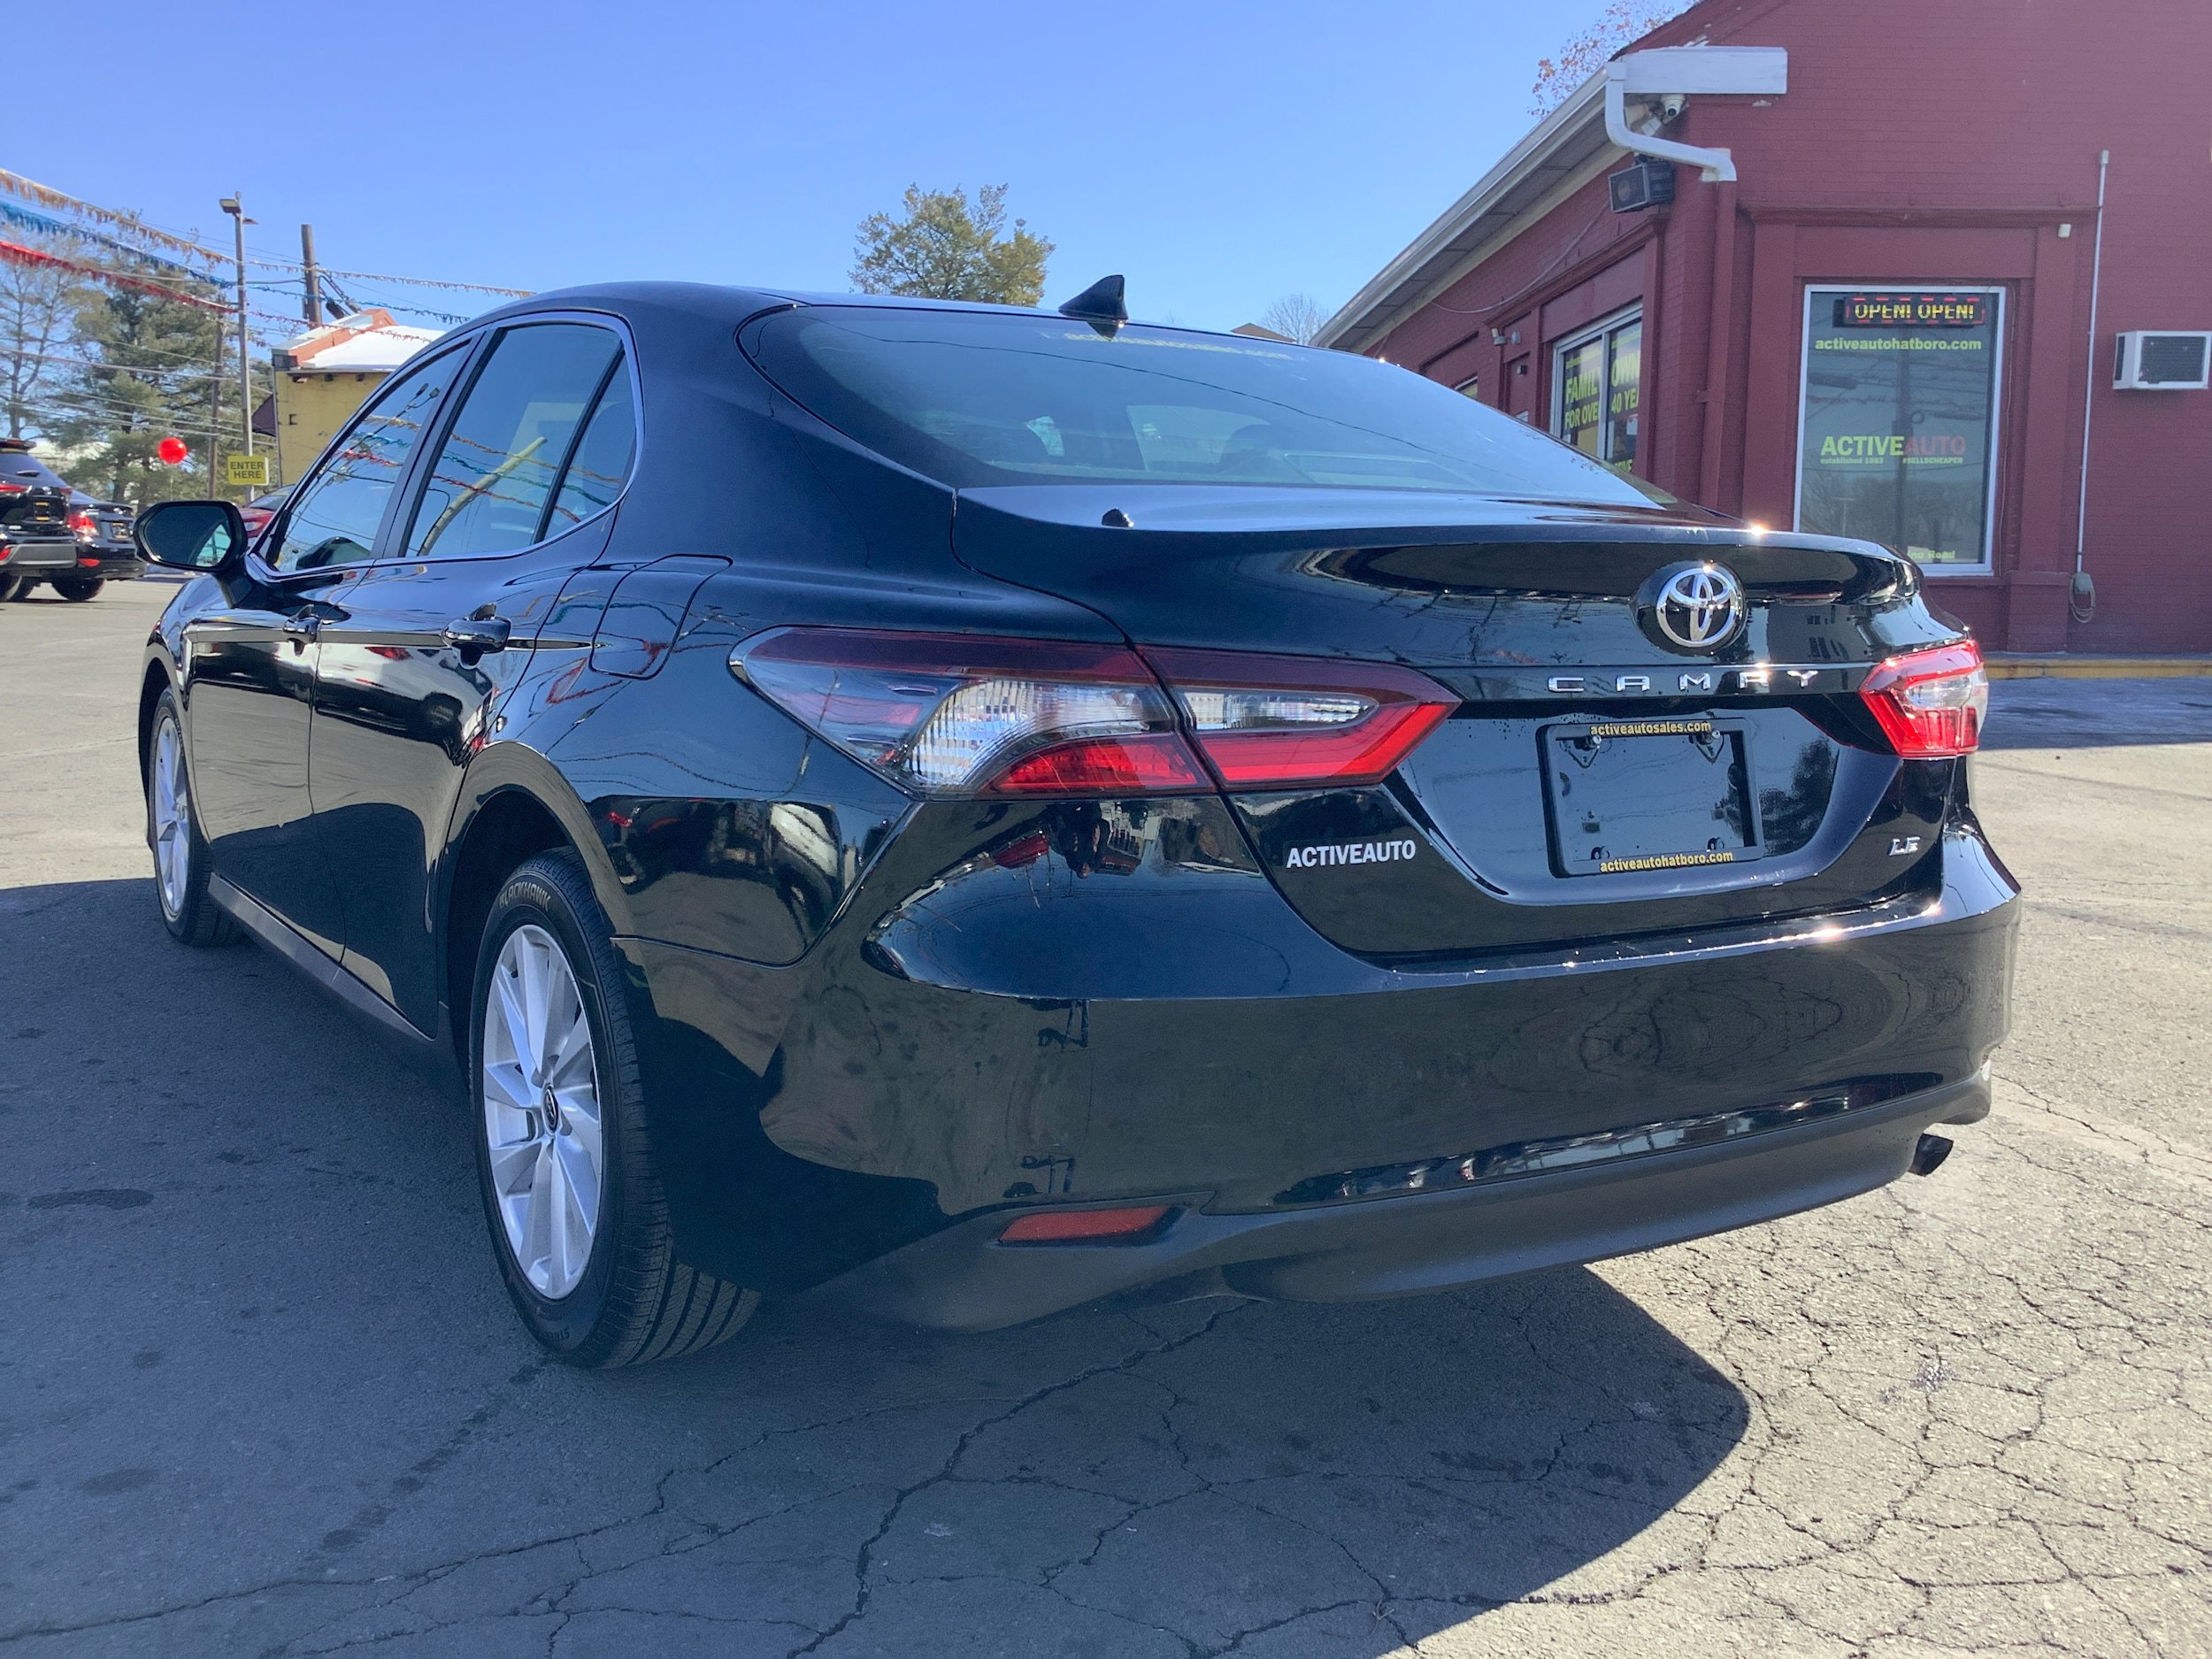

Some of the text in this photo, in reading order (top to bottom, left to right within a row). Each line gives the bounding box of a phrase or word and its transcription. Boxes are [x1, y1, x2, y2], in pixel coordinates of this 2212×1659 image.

[1855, 304, 1975, 319] OPEN! OPEN!
[1815, 337, 1982, 350] activeautohatboro.com
[1565, 368, 1600, 404] FAMIL
[1611, 352, 1640, 388] OWN
[1564, 408, 1580, 430] FOR
[1581, 401, 1600, 425] OVE
[1611, 392, 1622, 414] 40
[1820, 435, 1966, 456] ACTIVEAUTO
[1928, 549, 1955, 559] Road
[1548, 670, 1819, 693] CAMRY
[1590, 721, 1711, 736] activeautosales.com
[1286, 840, 1416, 869] ACTIVEAUTO
[1888, 836, 1921, 856] LE
[1600, 851, 1733, 873] activeautohatboro.com
[499, 881, 551, 912] BLACKHAWK
